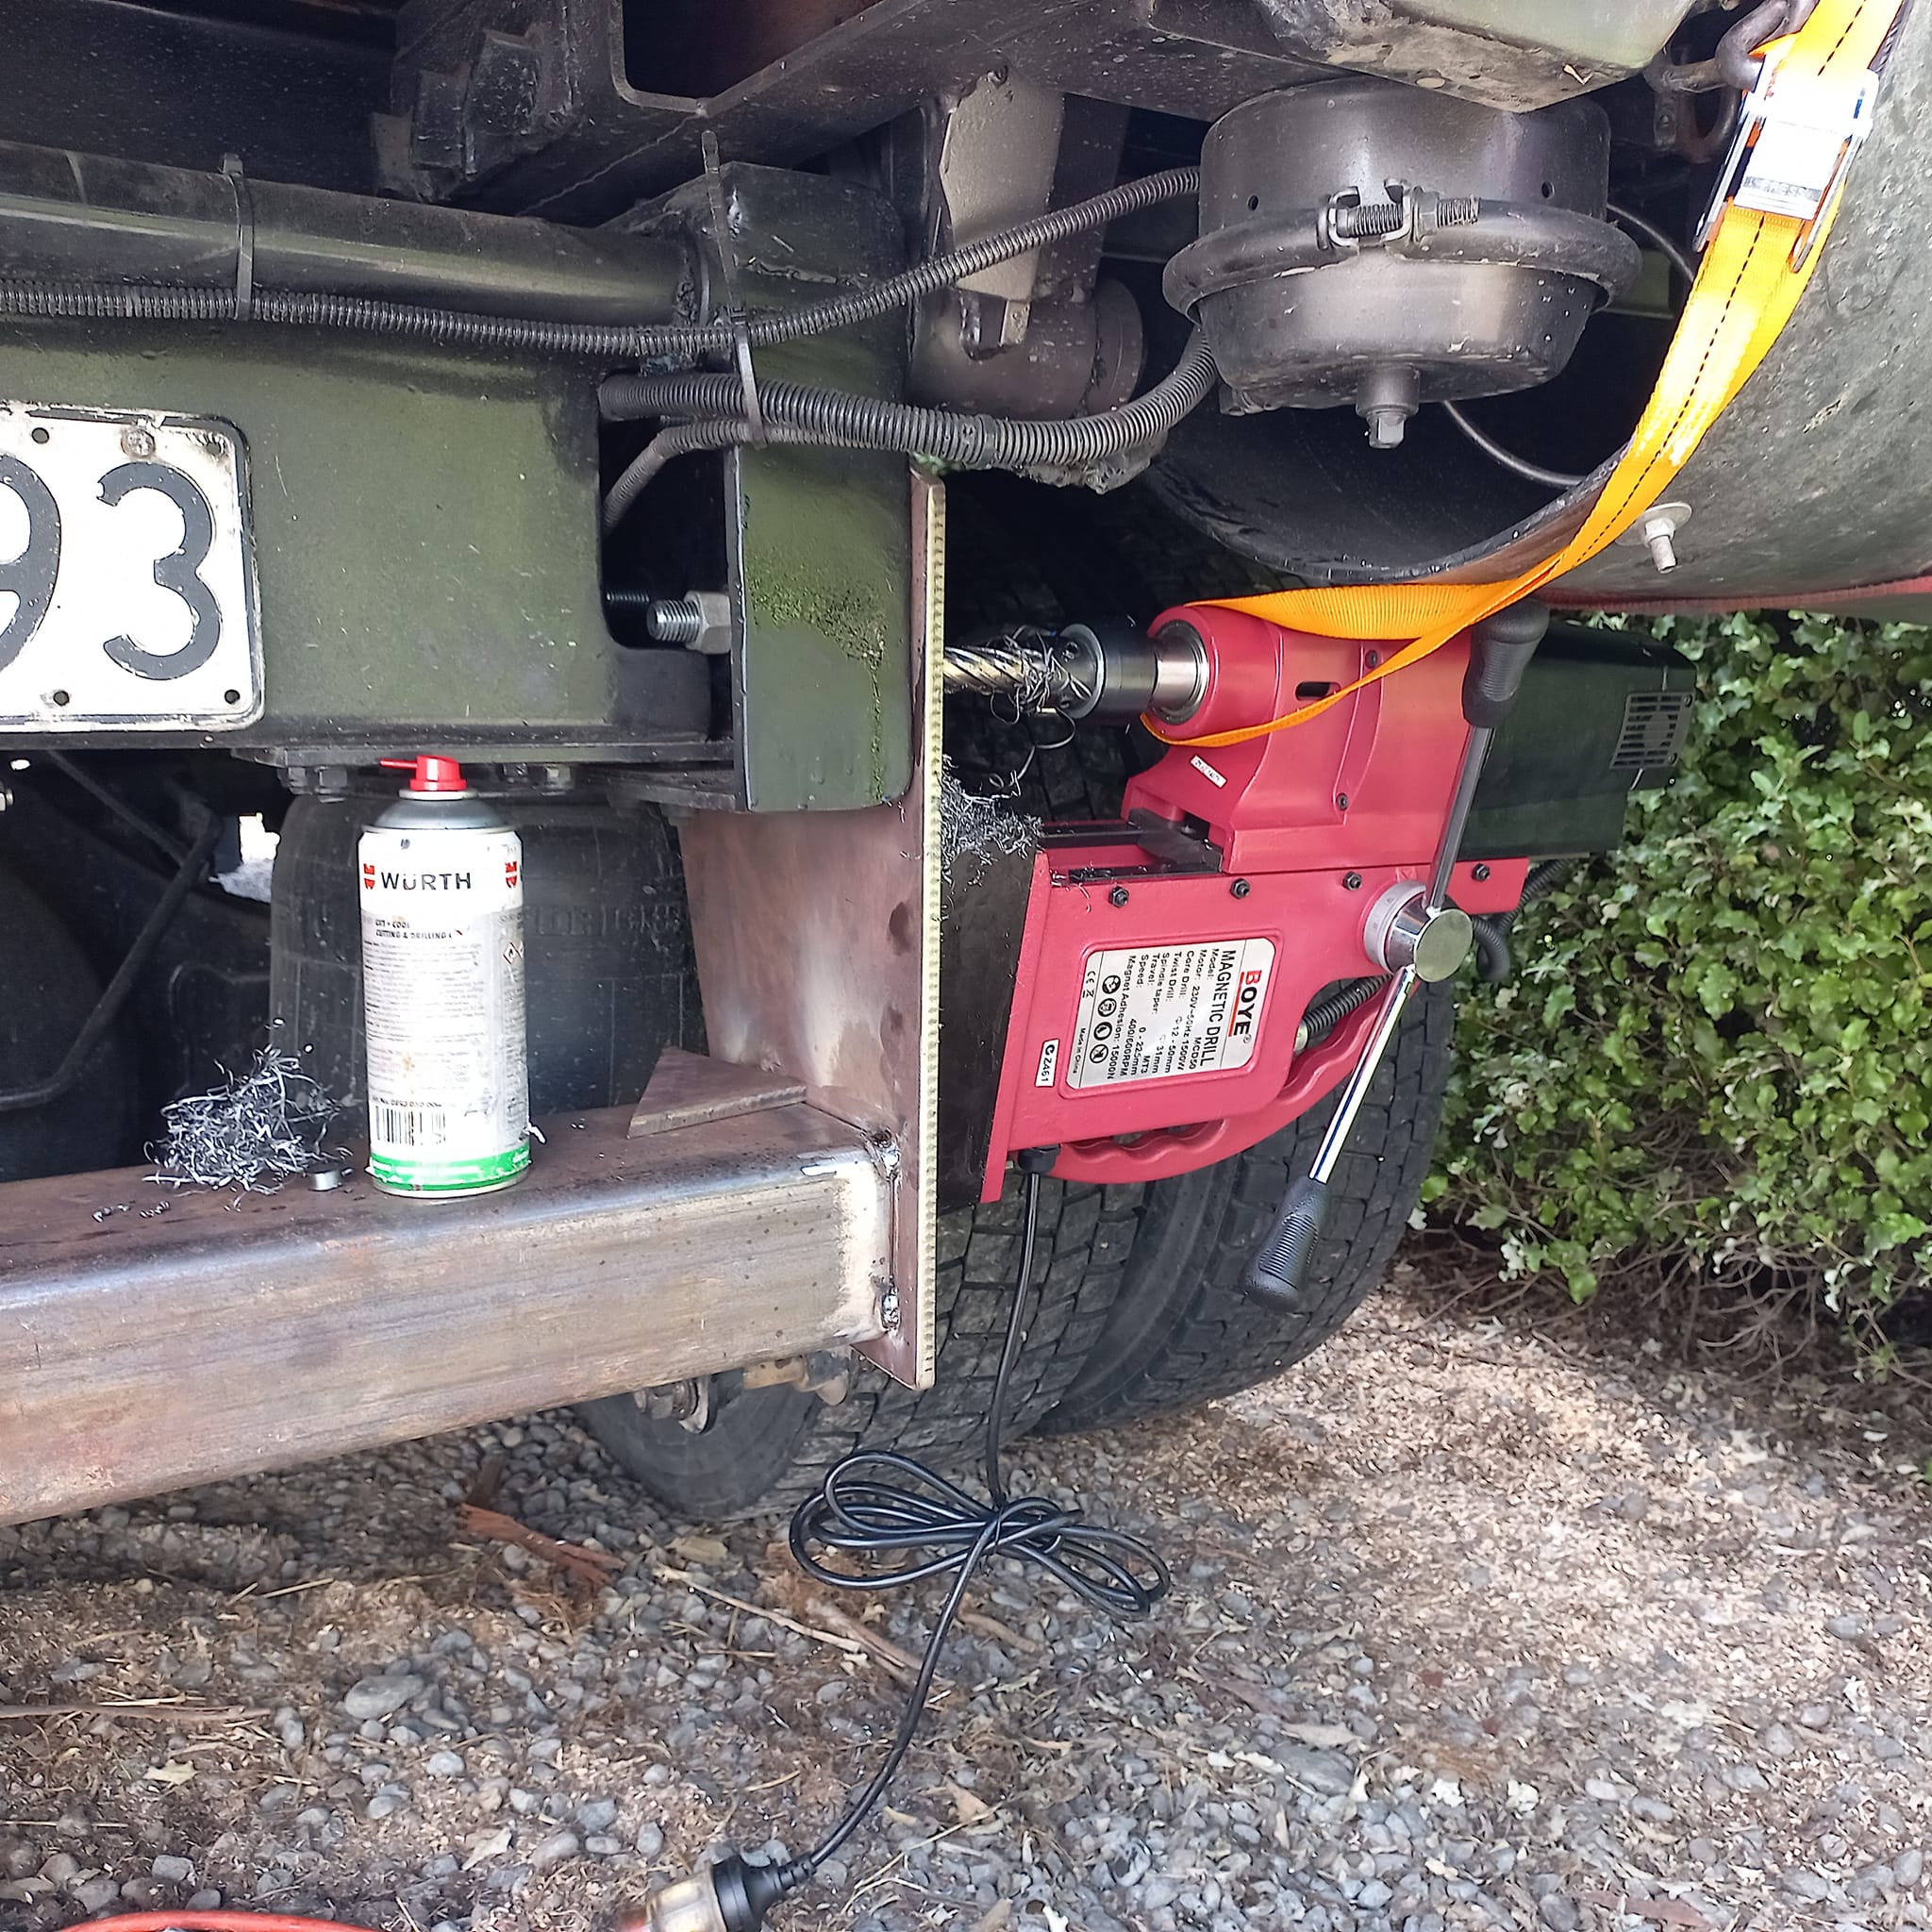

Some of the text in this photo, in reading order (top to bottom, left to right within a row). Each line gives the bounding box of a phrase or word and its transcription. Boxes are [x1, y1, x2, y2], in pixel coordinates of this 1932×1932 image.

[380, 872, 471, 891] WÜRTH
[1200, 950, 1236, 1066] MAGNETIC DRILL
[1234, 970, 1262, 1036] BOYE
